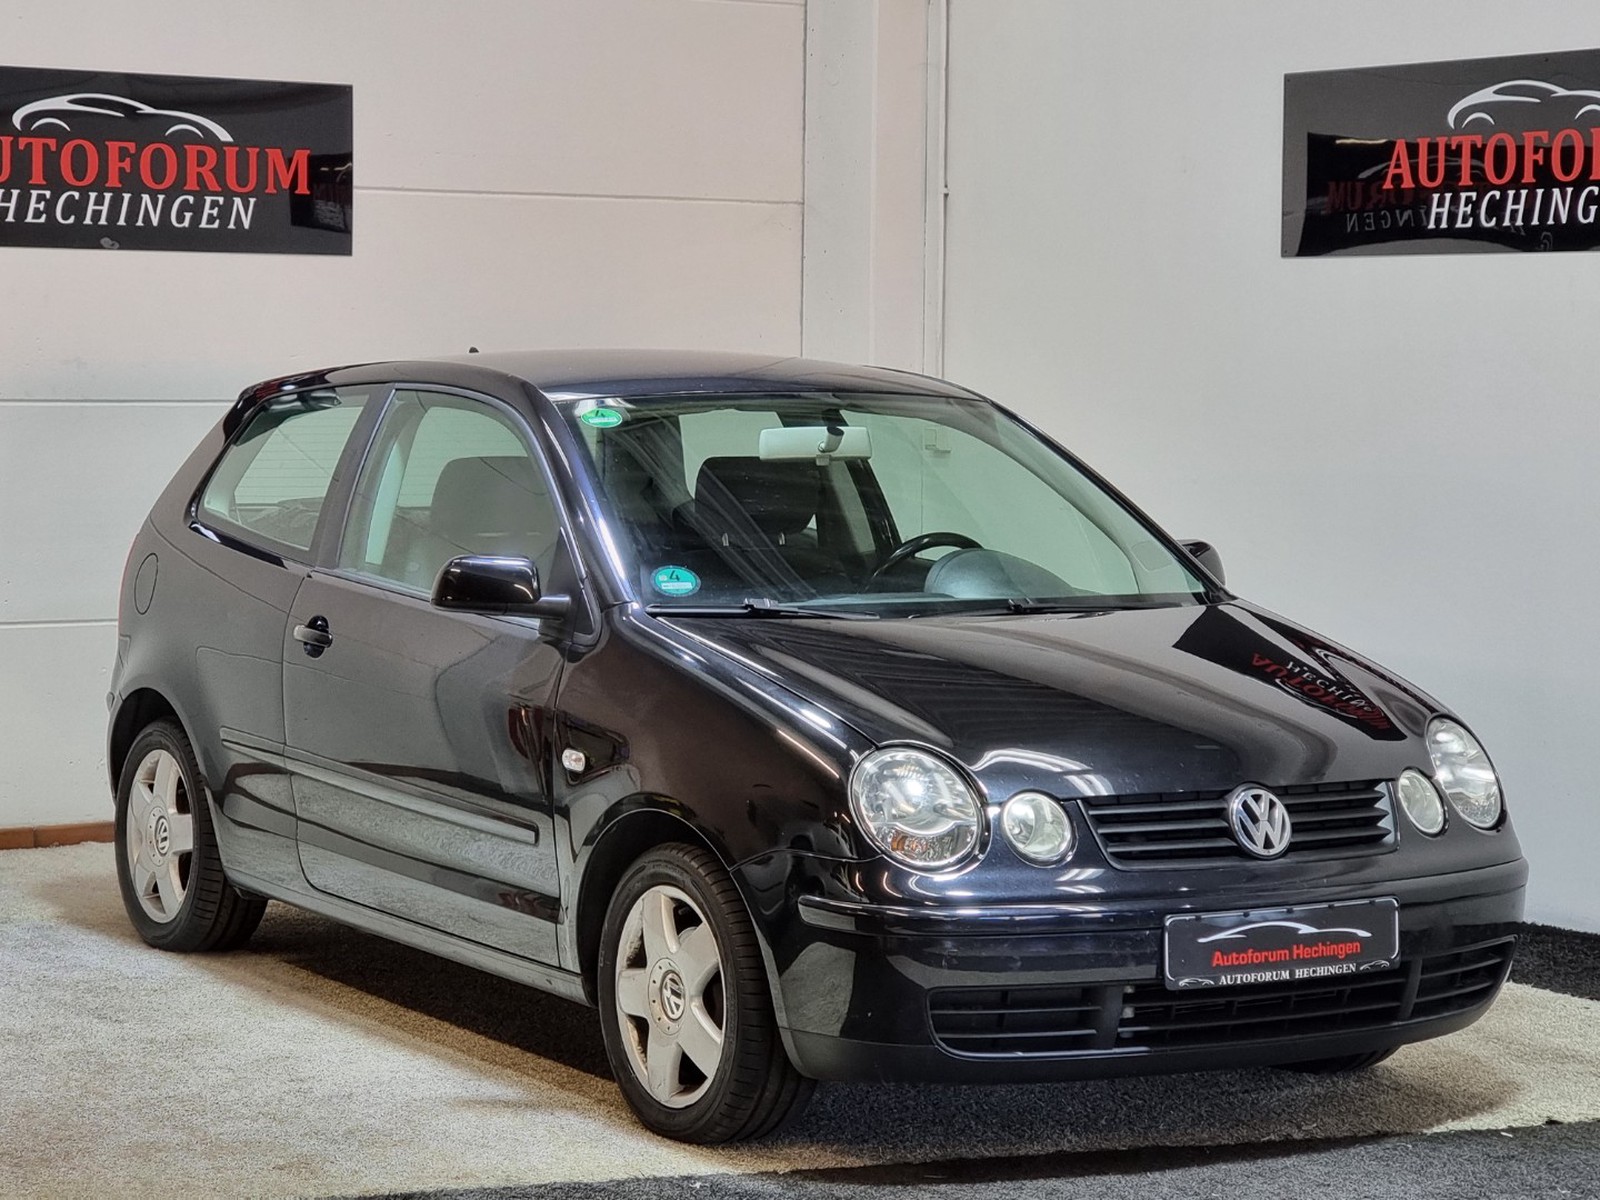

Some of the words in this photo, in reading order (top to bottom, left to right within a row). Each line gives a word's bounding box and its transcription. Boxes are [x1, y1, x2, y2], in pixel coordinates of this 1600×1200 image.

[0, 189, 256, 229] HECHINGEN
[1428, 186, 1599, 230] HECHING
[669, 570, 680, 581] 4
[1232, 785, 1291, 857] VW
[1212, 949, 1289, 967] Autoforum
[1293, 941, 1361, 959] Hechingen
[1219, 970, 1290, 985] AUTOFORUM
[1295, 963, 1357, 978] HECHINGEN
